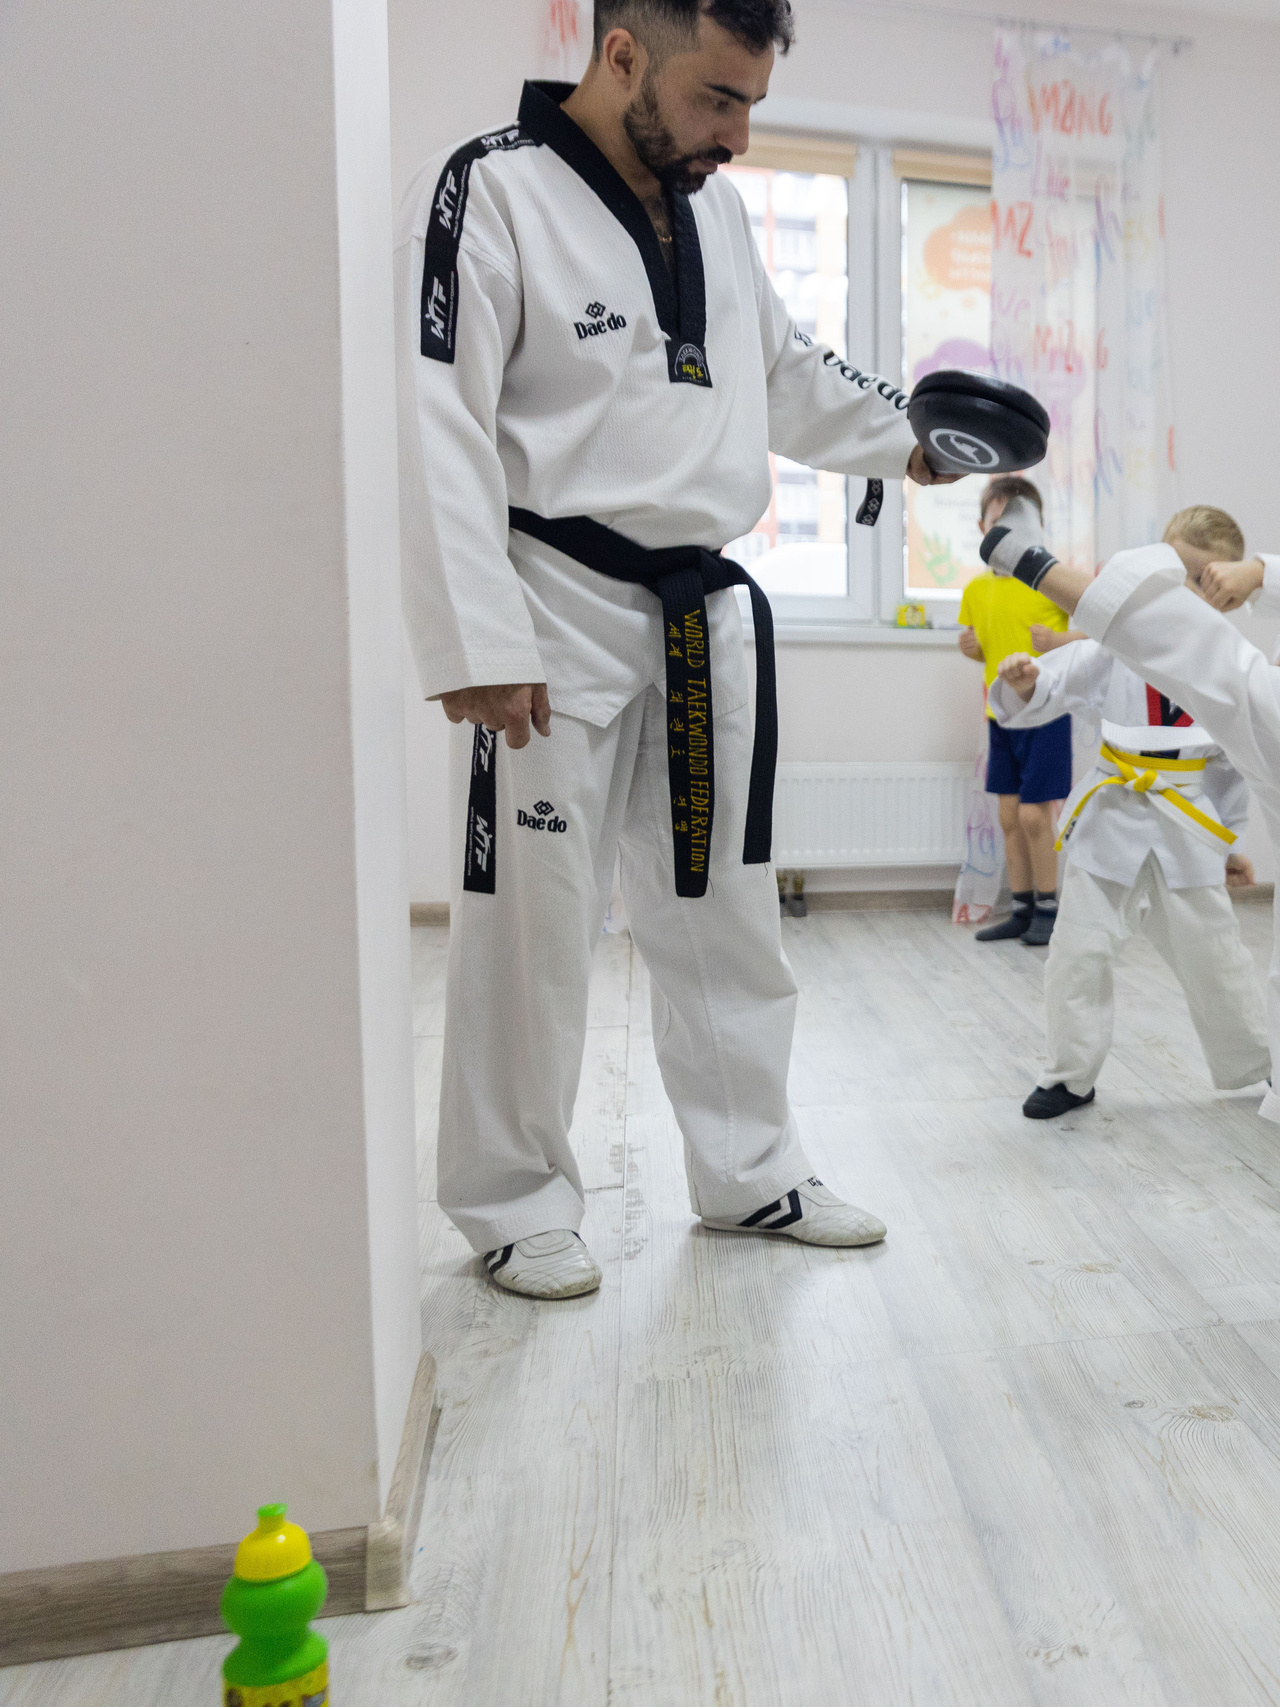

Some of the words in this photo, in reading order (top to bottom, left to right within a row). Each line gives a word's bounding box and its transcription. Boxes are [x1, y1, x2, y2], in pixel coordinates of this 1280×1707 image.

[435, 169, 457, 230] WTF
[425, 276, 447, 341] WTF
[684, 609, 706, 668] WORLD
[687, 677, 708, 775] TAEKWONDO
[474, 815, 493, 873] WTF
[690, 781, 710, 872] FEDERATION
